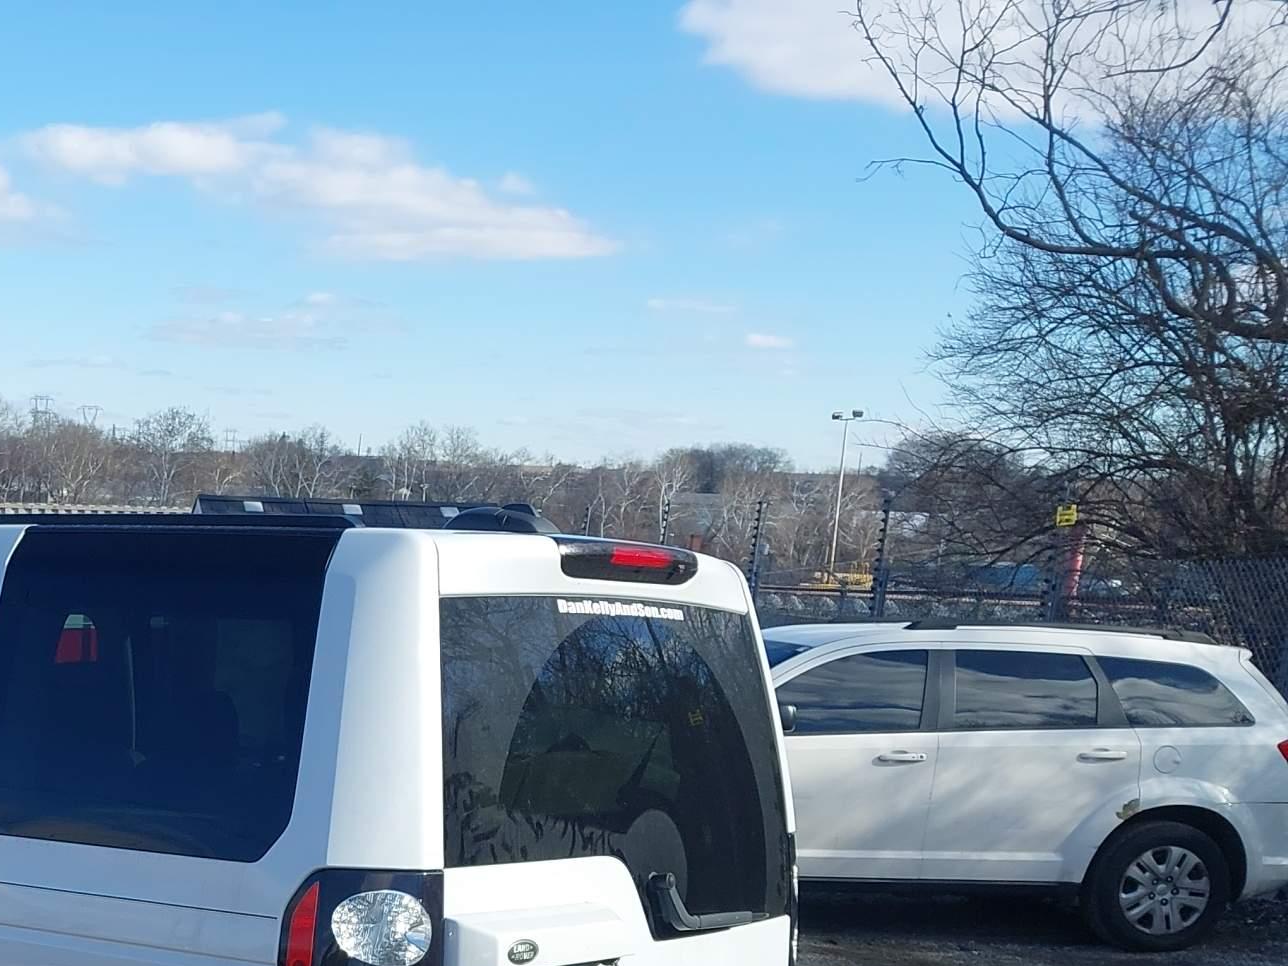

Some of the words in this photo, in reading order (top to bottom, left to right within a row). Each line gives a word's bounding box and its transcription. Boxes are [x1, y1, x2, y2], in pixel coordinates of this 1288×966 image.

[557, 599, 684, 621] DanKellyAndSon.com
[513, 943, 530, 953] LAND
[514, 951, 534, 961] ROVER
